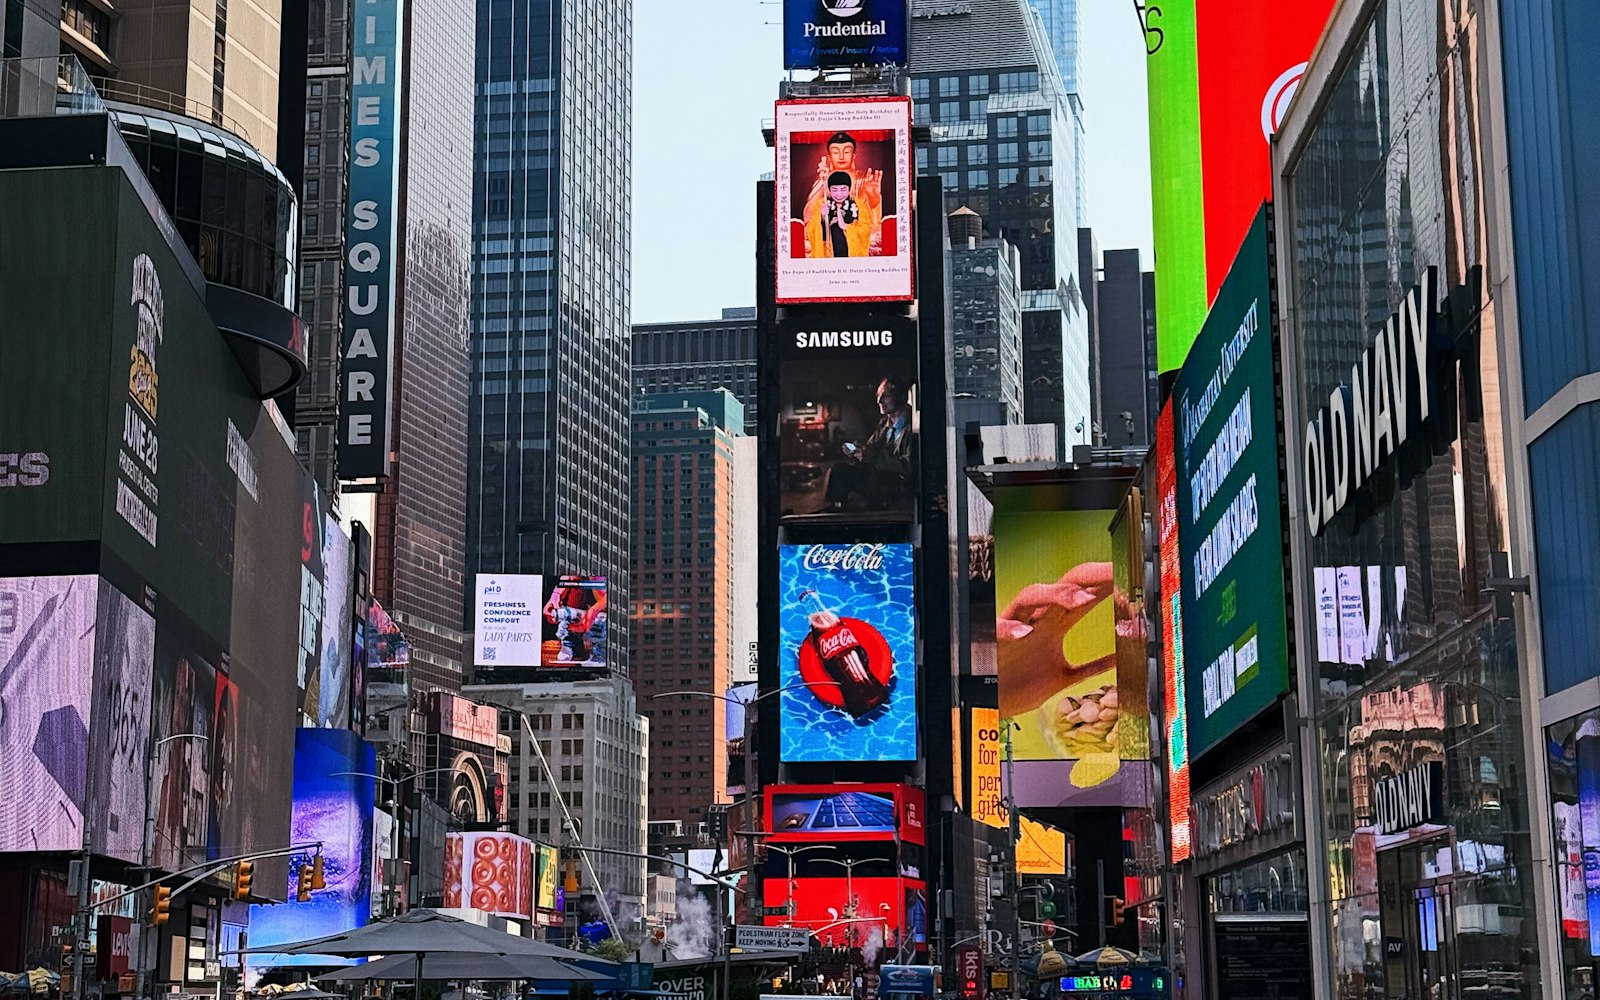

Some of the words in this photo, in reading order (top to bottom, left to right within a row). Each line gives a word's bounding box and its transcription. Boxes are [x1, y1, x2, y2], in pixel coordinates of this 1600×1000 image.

[803, 20, 886, 37] Prudential
[353, 0, 386, 168] IMES
[346, 200, 380, 445] SQUARE
[796, 330, 893, 348] SAMSUNG
[1221, 298, 1258, 384] UNIVERSITY
[1305, 386, 1348, 537] OLD
[1352, 266, 1429, 491] NAVY
[122, 402, 146, 462] JUNE
[146, 430, 158, 474] 28
[1230, 471, 1258, 556] SALARIES
[804, 543, 886, 570] Coca-Cola
[484, 632, 505, 642] LADY
[506, 632, 533, 642] PARTS
[979, 744, 997, 764] for
[978, 776, 1000, 796] per
[1376, 778, 1398, 834] OLD
[1398, 762, 1431, 828] NAVY
[966, 950, 979, 979] tkts
